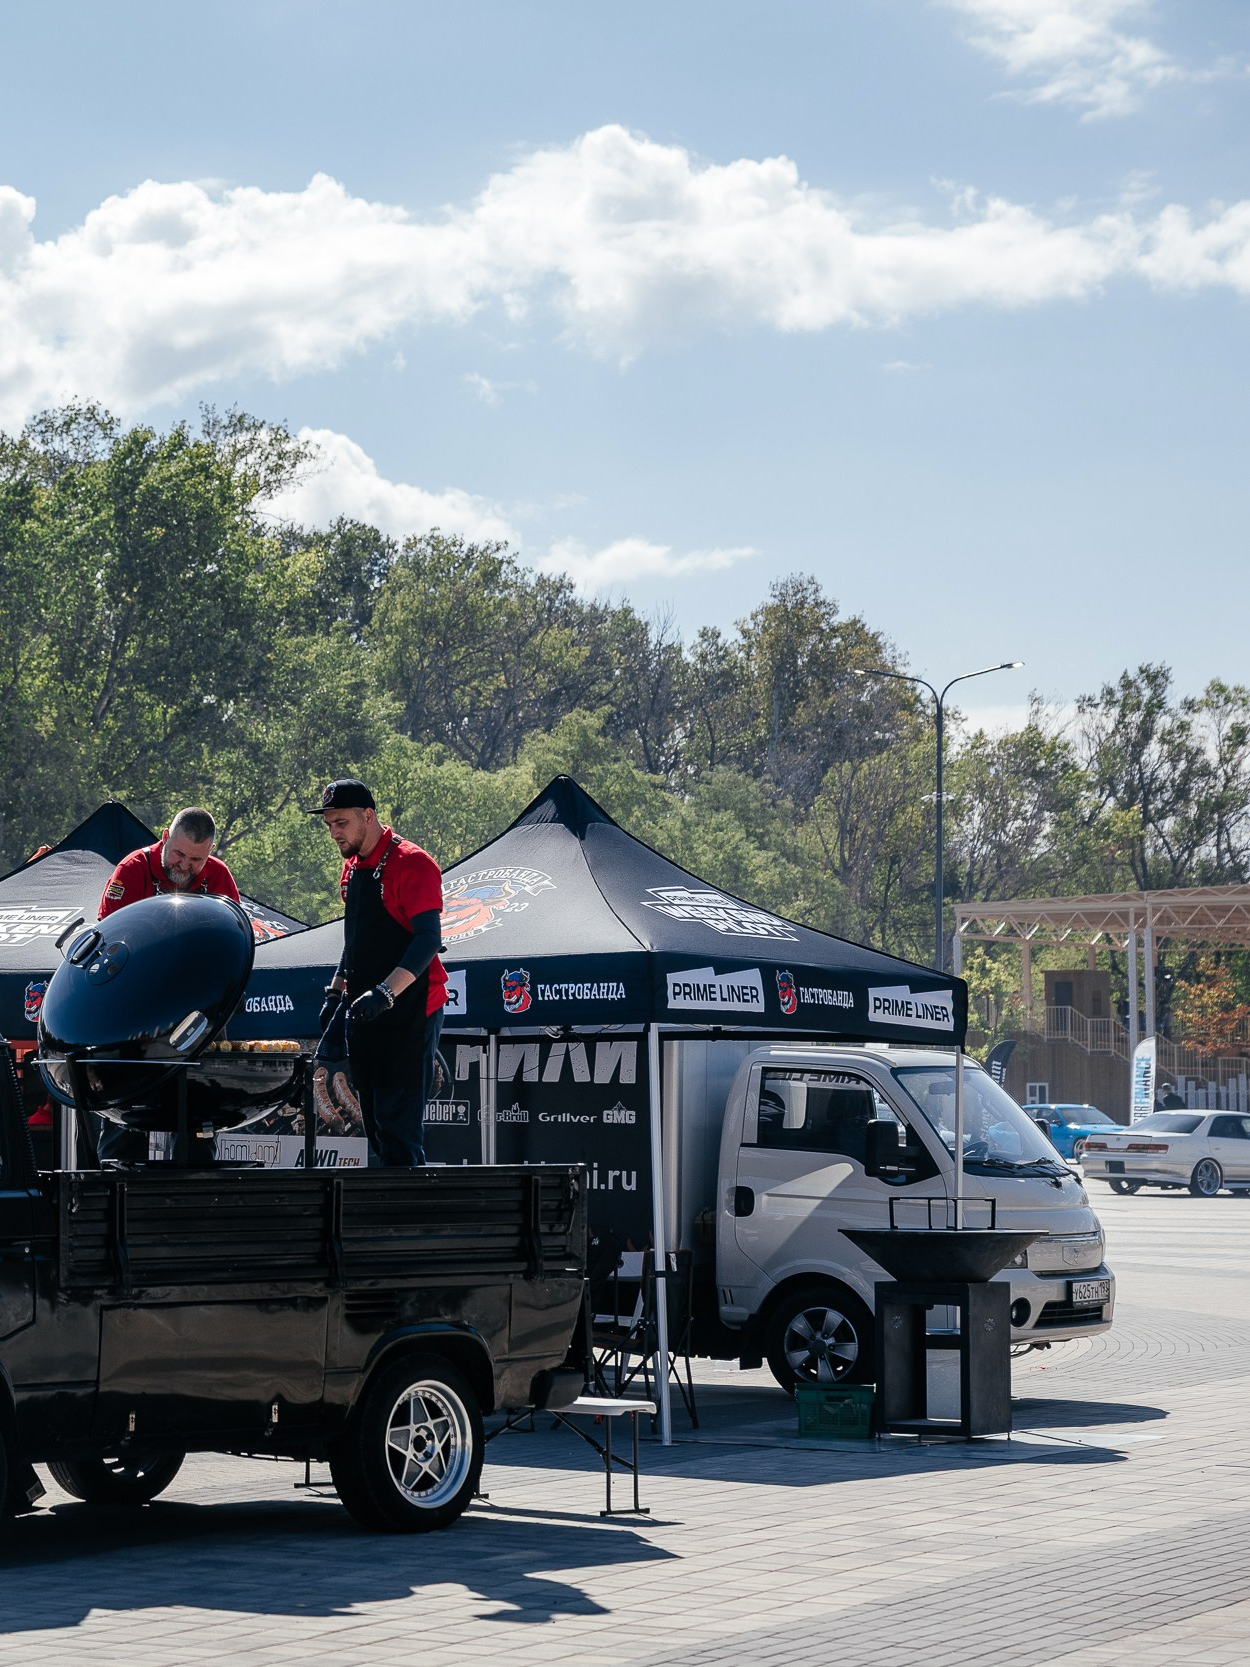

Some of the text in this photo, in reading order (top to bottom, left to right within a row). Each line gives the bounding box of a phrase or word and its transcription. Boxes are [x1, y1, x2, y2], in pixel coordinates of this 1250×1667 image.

[449, 868, 543, 889] ГАСТРОБАНДА
[17, 914, 59, 922] LINER
[654, 905, 783, 926] WEEKEND
[701, 918, 783, 937] PILOT
[537, 982, 626, 1001] ГАСТРОБАНДА
[673, 982, 760, 1004] PRIME LINER
[799, 986, 854, 1008] ГАСТРОБАНДА
[245, 995, 295, 1013] ОБАНДА
[873, 997, 950, 1023] PRIME LINER
[538, 1112, 597, 1124] Grillver
[602, 1109, 636, 1124] GMG
